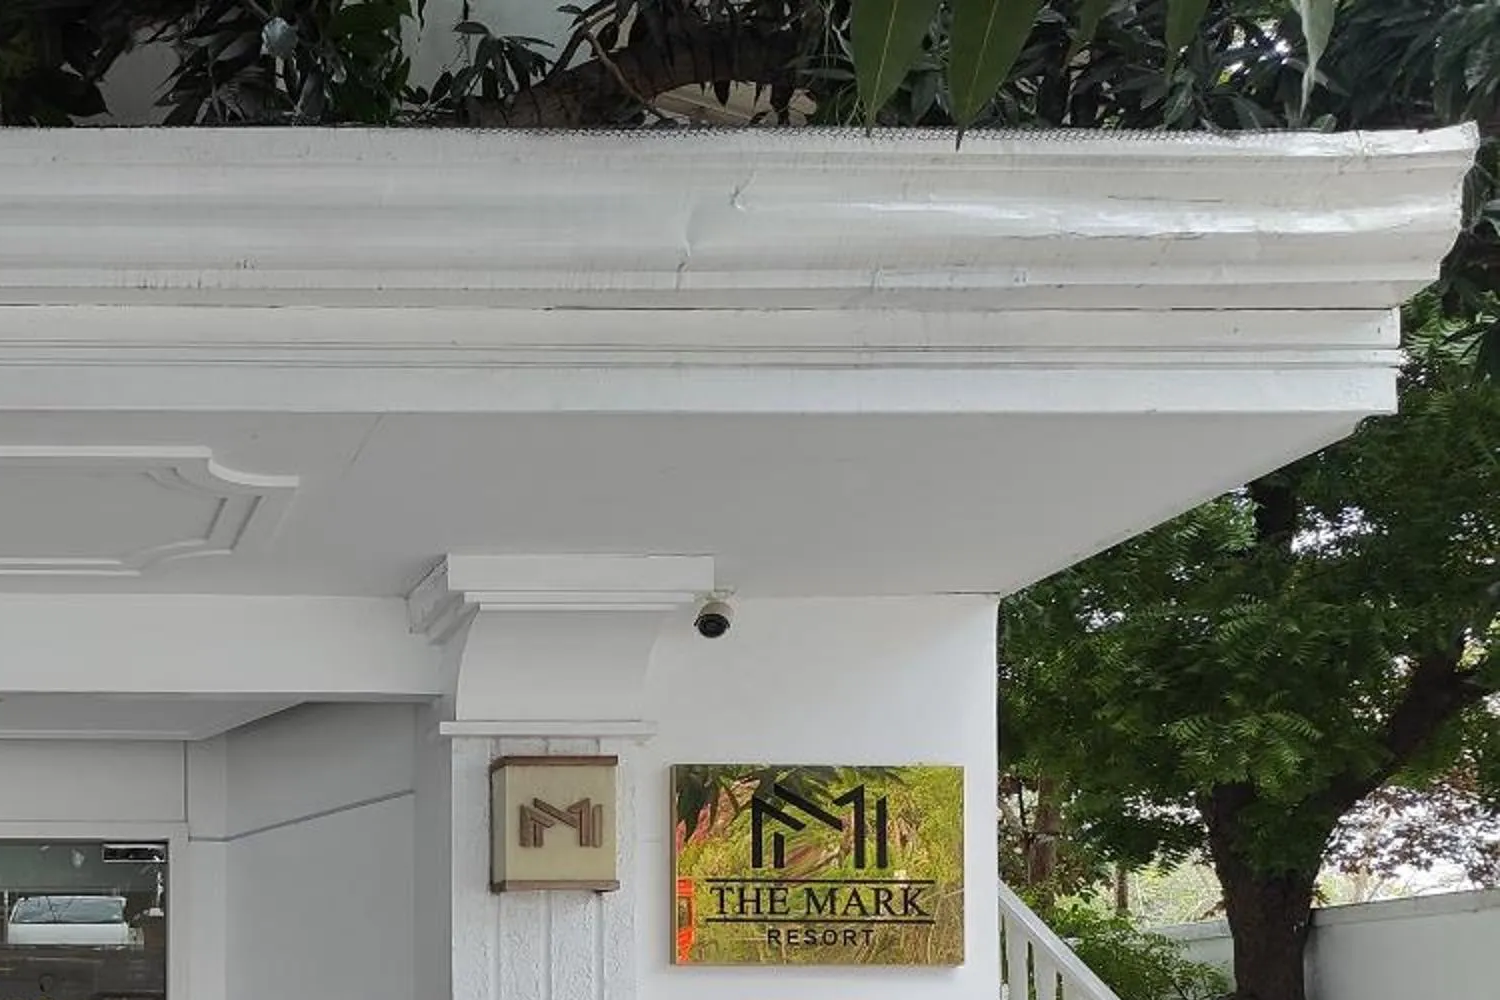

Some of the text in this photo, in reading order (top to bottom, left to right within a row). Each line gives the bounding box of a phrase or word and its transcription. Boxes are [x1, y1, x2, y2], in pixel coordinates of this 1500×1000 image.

[709, 887, 930, 917] THE MARK
[766, 929, 875, 946] RESORT
